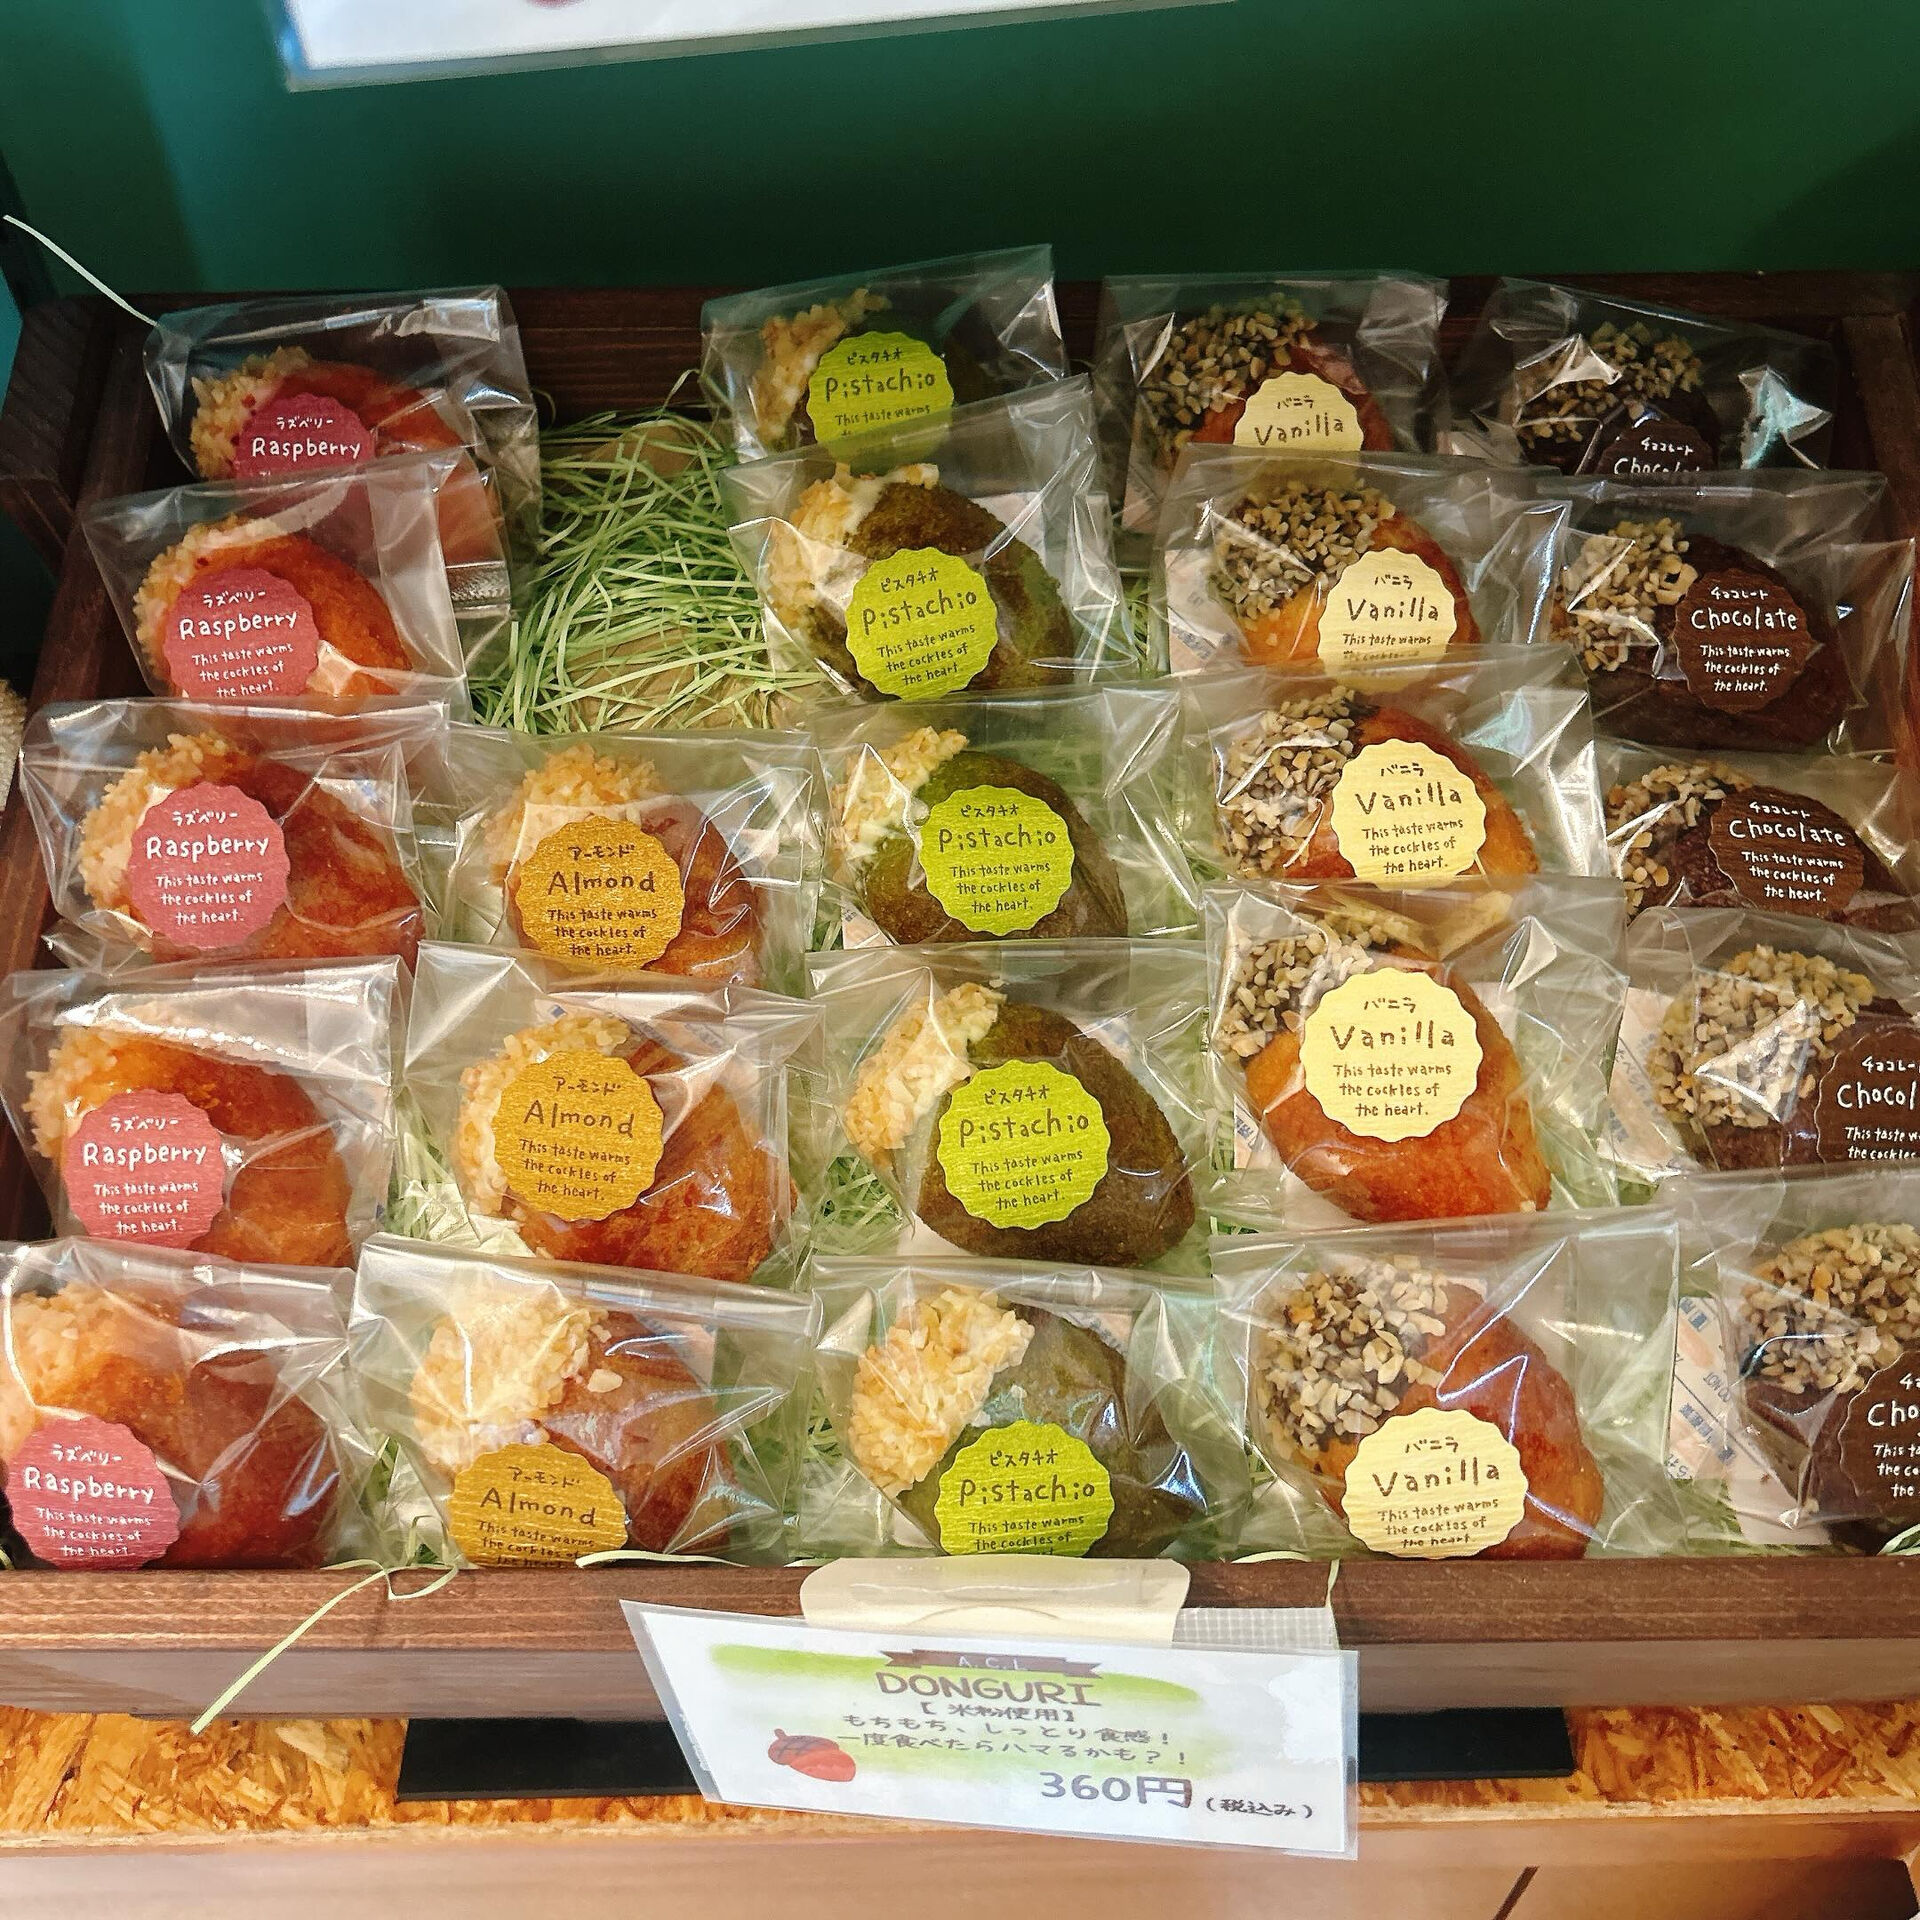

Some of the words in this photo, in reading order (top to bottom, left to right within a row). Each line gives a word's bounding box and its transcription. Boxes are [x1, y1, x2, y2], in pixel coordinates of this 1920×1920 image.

[848, 348, 902, 365] ピスタチオ
[826, 368, 935, 402] Pistachio
[1277, 395, 1314, 409] バニラ
[277, 416, 333, 430] ラズベリー
[1255, 412, 1343, 445] Vanilla
[252, 438, 360, 462] Raspberry
[881, 567, 938, 593] ピスタチオ
[1375, 574, 1412, 589] バニラ
[203, 591, 266, 608] ラズベリー
[1711, 587, 1768, 600] チョコレート
[863, 589, 976, 635] Pistachio
[1348, 597, 1438, 621] Vanilla
[179, 612, 297, 640] Raspberry
[1692, 606, 1797, 630] Chocolate
[877, 644, 902, 658] This
[905, 635, 935, 652] taste
[938, 624, 975, 641] warms
[1343, 633, 1365, 645] This
[1369, 634, 1396, 646] taste
[1399, 636, 1431, 644] warms
[192, 654, 218, 666] This
[221, 649, 251, 663] taste
[256, 643, 293, 656] warms
[1700, 645, 1723, 657] This
[1727, 645, 1755, 657] taste
[1756, 648, 1790, 657] warms
[886, 661, 905, 672] the
[910, 649, 954, 667] cockles
[1704, 662, 1721, 673] the
[1725, 663, 1764, 675] cockles
[1768, 663, 1780, 676] of
[200, 671, 219, 681] the
[224, 665, 269, 679] cockles
[902, 674, 922, 685] the
[217, 687, 236, 697] the
[1714, 680, 1731, 691] the
[1735, 680, 1768, 692] heart.
[1381, 763, 1424, 776] バニラ
[1356, 782, 1462, 815] Vanilla
[173, 809, 238, 826] ラズベリー
[961, 803, 1019, 817] ピスタチオ
[1750, 801, 1810, 818] チョコレート
[939, 824, 1056, 853] Pistachio
[1362, 828, 1388, 840] This
[1392, 823, 1423, 837] taste
[1426, 820, 1463, 832] warms
[1729, 818, 1846, 846] Chocolate
[146, 835, 268, 863] Raspberry
[568, 844, 635, 860] アーモンド
[1369, 844, 1390, 856] the
[1394, 841, 1439, 854] cockles
[1444, 836, 1456, 849] of
[1384, 862, 1404, 874] the
[1409, 856, 1448, 872] heart.
[1741, 852, 1768, 863] This
[1772, 853, 1803, 866] taste
[1807, 858, 1844, 869] warms
[951, 866, 976, 878] This
[979, 864, 1010, 877] taste
[1014, 863, 1050, 873] warms
[1749, 866, 1770, 878] the
[1773, 870, 1820, 884] cockles
[1822, 874, 1835, 886] of
[156, 875, 182, 888] This
[186, 874, 218, 887] taste
[222, 872, 262, 884] warms
[548, 871, 655, 895] Almond
[957, 883, 976, 894] the
[981, 882, 1025, 892] cockles
[1029, 879, 1041, 891] of
[161, 894, 181, 905] the
[186, 892, 235, 905] cockles
[1764, 884, 1784, 898] the
[1789, 886, 1826, 901] heart.
[547, 909, 575, 921] This
[580, 909, 612, 921] taste
[617, 909, 657, 919] warms
[972, 901, 991, 913] the
[176, 912, 196, 925] the
[554, 926, 574, 938] the
[580, 926, 627, 938] cockles
[570, 944, 590, 955] the
[1364, 997, 1416, 1013] バニラ
[1330, 1020, 1454, 1050] Vanilla
[1333, 1064, 1363, 1077] This
[1368, 1064, 1403, 1077] taste
[1408, 1065, 1451, 1075] warms
[1862, 1056, 1920, 1073] チョコレー
[553, 1076, 621, 1096] アーモンド
[1339, 1083, 1362, 1095] the
[1367, 1084, 1420, 1096] cockles
[1426, 1084, 1439, 1096] of
[985, 1085, 1050, 1105] ピスタチオ
[1356, 1103, 1378, 1117] the
[1385, 1103, 1428, 1116] heart.
[111, 1116, 179, 1133] ラズベリー
[524, 1100, 634, 1138] Almond
[960, 1108, 1089, 1148] Pistachio
[1845, 1127, 1870, 1141] This
[1875, 1128, 1905, 1141] taste
[83, 1143, 206, 1171] Raspberry
[520, 1139, 547, 1150] This
[551, 1143, 585, 1159] taste
[589, 1151, 631, 1165] warms
[1848, 1146, 1867, 1158] the
[523, 1159, 544, 1172] the
[549, 1165, 598, 1181] cockles
[603, 1172, 616, 1183] of
[973, 1162, 999, 1174] This
[1003, 1156, 1037, 1171] taste
[1042, 1151, 1083, 1164] warms
[93, 1184, 120, 1196] This
[124, 1183, 156, 1196] taste
[160, 1182, 198, 1193] warms
[537, 1180, 558, 1193] the
[979, 1180, 1000, 1192] the
[1005, 1173, 1055, 1189] cockles
[1060, 1169, 1072, 1182] of
[99, 1203, 120, 1215] the
[124, 1202, 172, 1214] cockles
[996, 1197, 1018, 1210] the
[117, 1221, 137, 1234] the
[1405, 1437, 1458, 1453] バニラ
[1873, 1444, 1904, 1458] This
[52, 1444, 122, 1465] ラズベリー
[990, 1449, 1058, 1467] ピスタチオ
[509, 1466, 580, 1487] アーモンド
[1372, 1458, 1499, 1496] Vanilla
[1877, 1463, 1900, 1476] the
[24, 1466, 154, 1504] Raspberry
[960, 1474, 1095, 1506] Pistachio
[1891, 1484, 1915, 1498] the
[480, 1488, 595, 1527] Almond
[875, 1672, 1102, 1706] DONGURI
[1039, 1772, 1192, 1809] 360円
